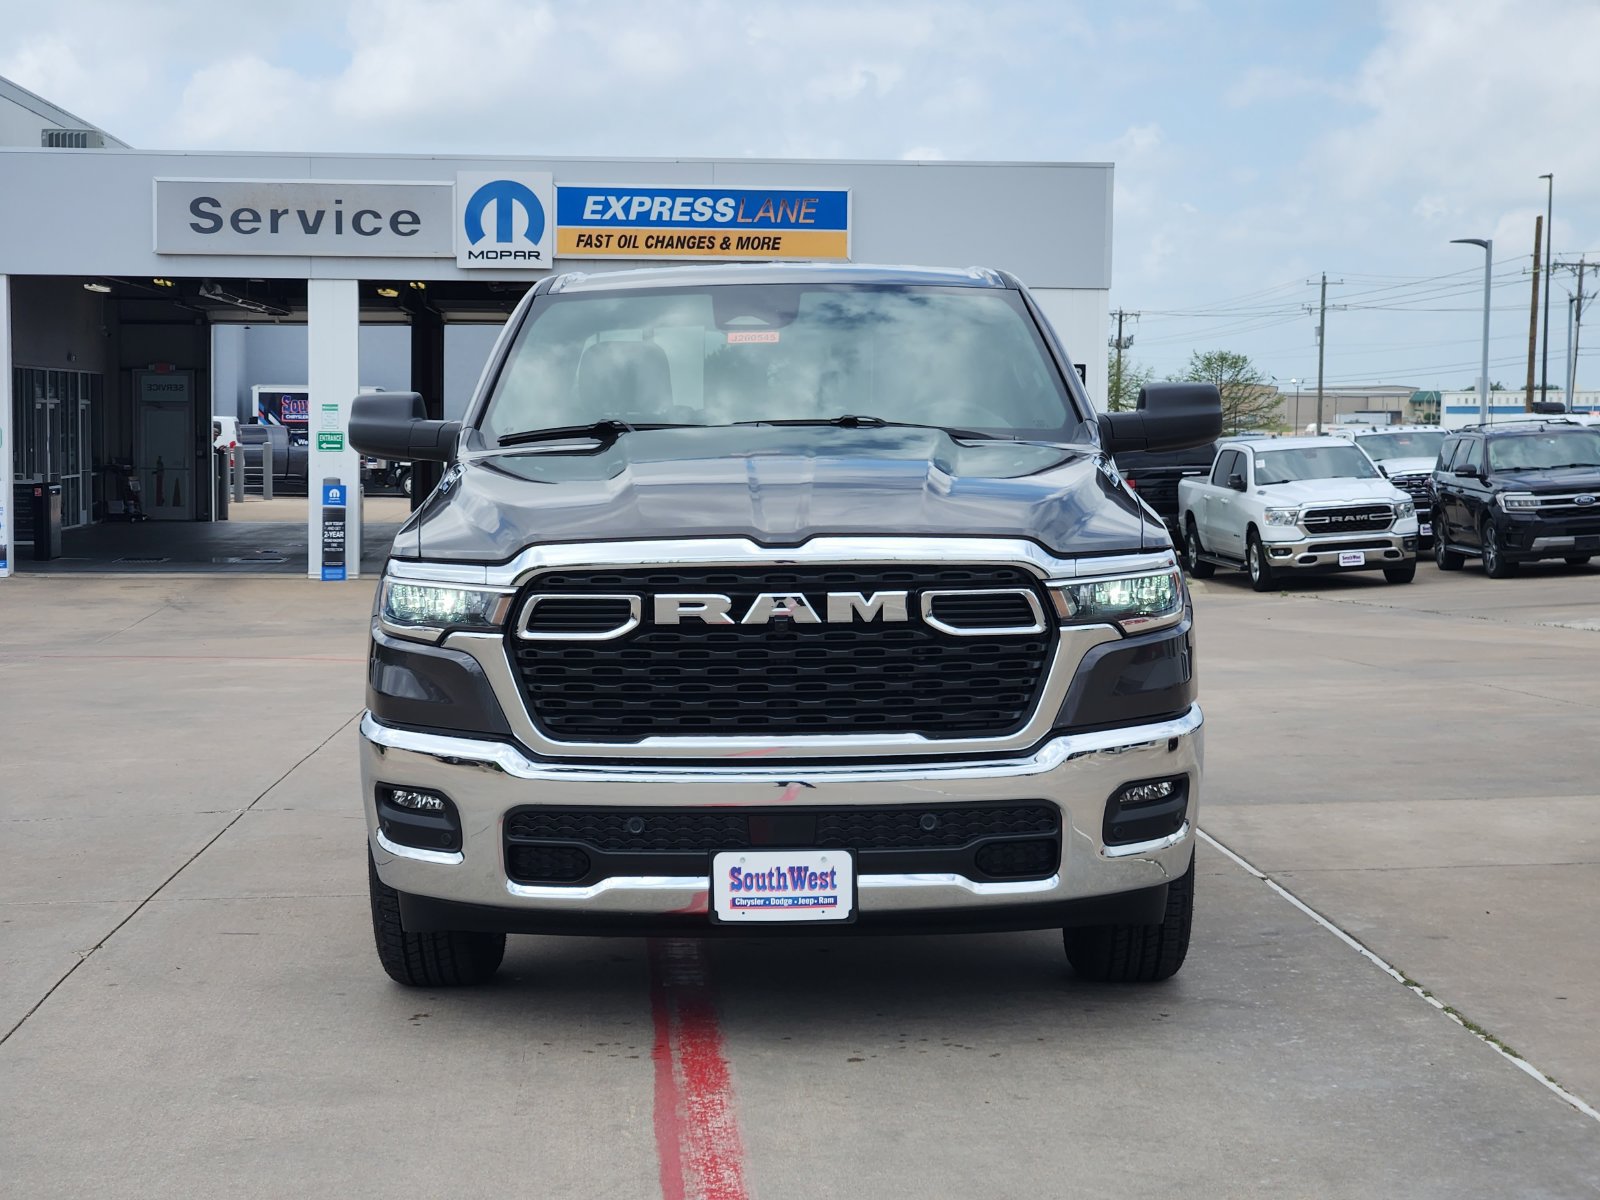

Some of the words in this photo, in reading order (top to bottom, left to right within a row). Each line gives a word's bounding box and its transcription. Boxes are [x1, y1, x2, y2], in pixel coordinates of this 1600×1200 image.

[188, 196, 422, 237] Service
[576, 234, 613, 248] FAST
[617, 235, 639, 249] OIL
[644, 235, 715, 250] CHANGES
[719, 236, 731, 250] &
[735, 236, 781, 251] MORE
[468, 250, 543, 261] MOPAR
[1331, 514, 1370, 522] RAM
[654, 592, 909, 625] RAM
[729, 866, 837, 892] SouthWest
[735, 897, 765, 906] Chrysler
[770, 897, 793, 906] Dodge
[798, 897, 814, 906] Jeep
[818, 896, 834, 904] Ram
